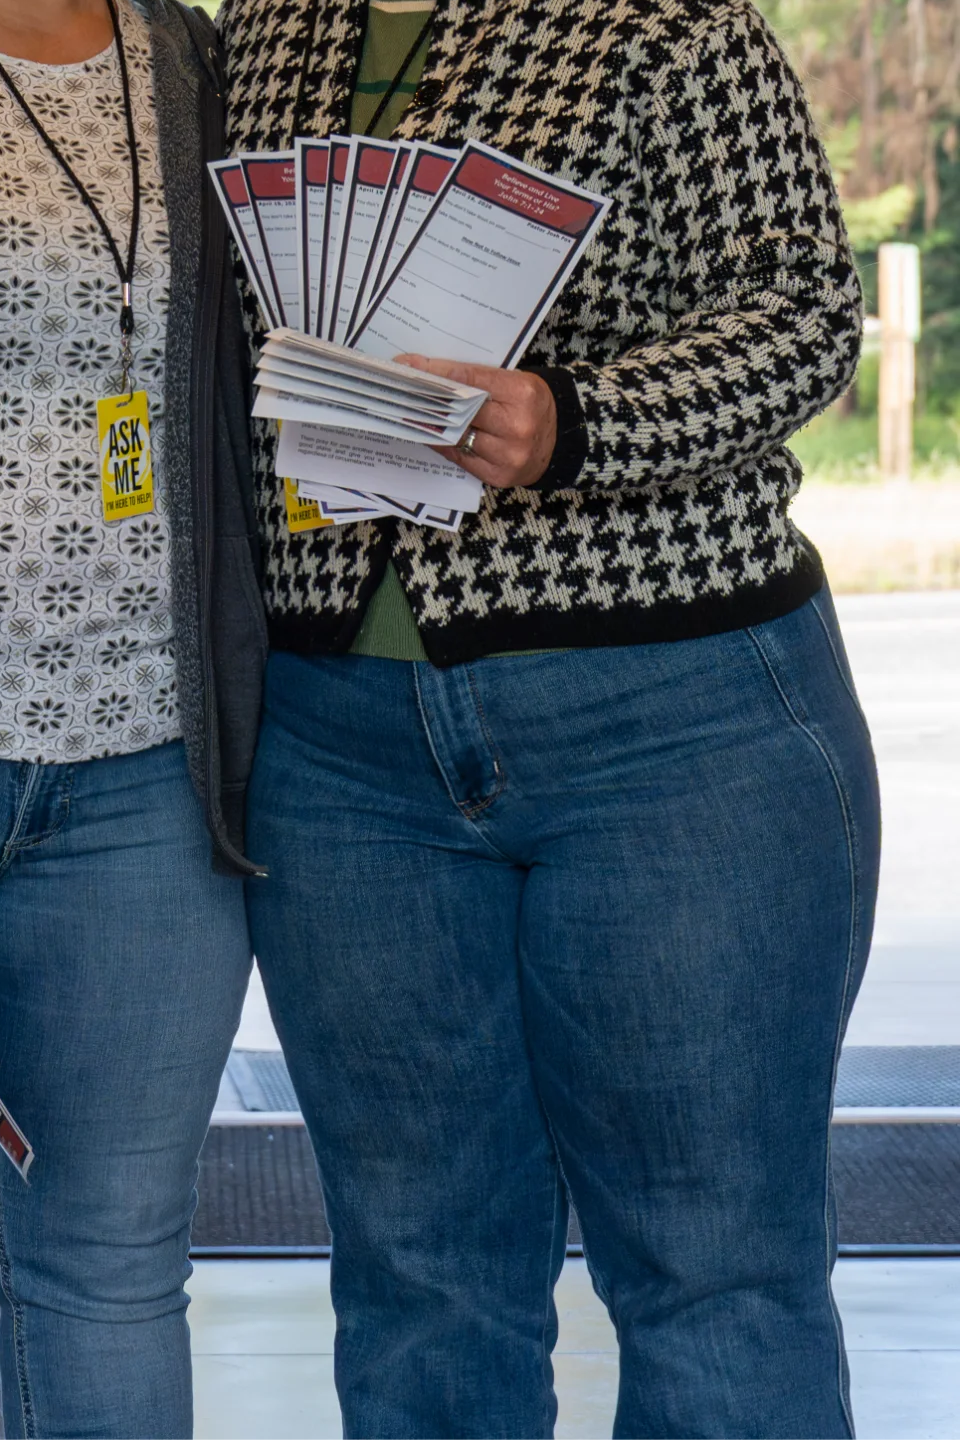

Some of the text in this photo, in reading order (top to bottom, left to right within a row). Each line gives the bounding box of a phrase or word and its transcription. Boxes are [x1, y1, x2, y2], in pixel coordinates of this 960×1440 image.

[452, 188, 467, 197] April
[494, 178, 512, 191] Your
[512, 187, 534, 201] Terms
[543, 202, 560, 212] His?
[502, 173, 560, 203] Believe and Live
[498, 192, 544, 215] John 7:1-24
[527, 223, 571, 244] Pastor Josh Fox
[109, 418, 142, 458] ASK
[298, 448, 327, 458] regardless
[352, 446, 374, 454] another
[375, 451, 394, 459] asking
[385, 459, 402, 468] willing
[114, 457, 142, 495] ME
[106, 493, 152, 511] I'M HERE TO HELP!
[299, 510, 311, 521] HERE
